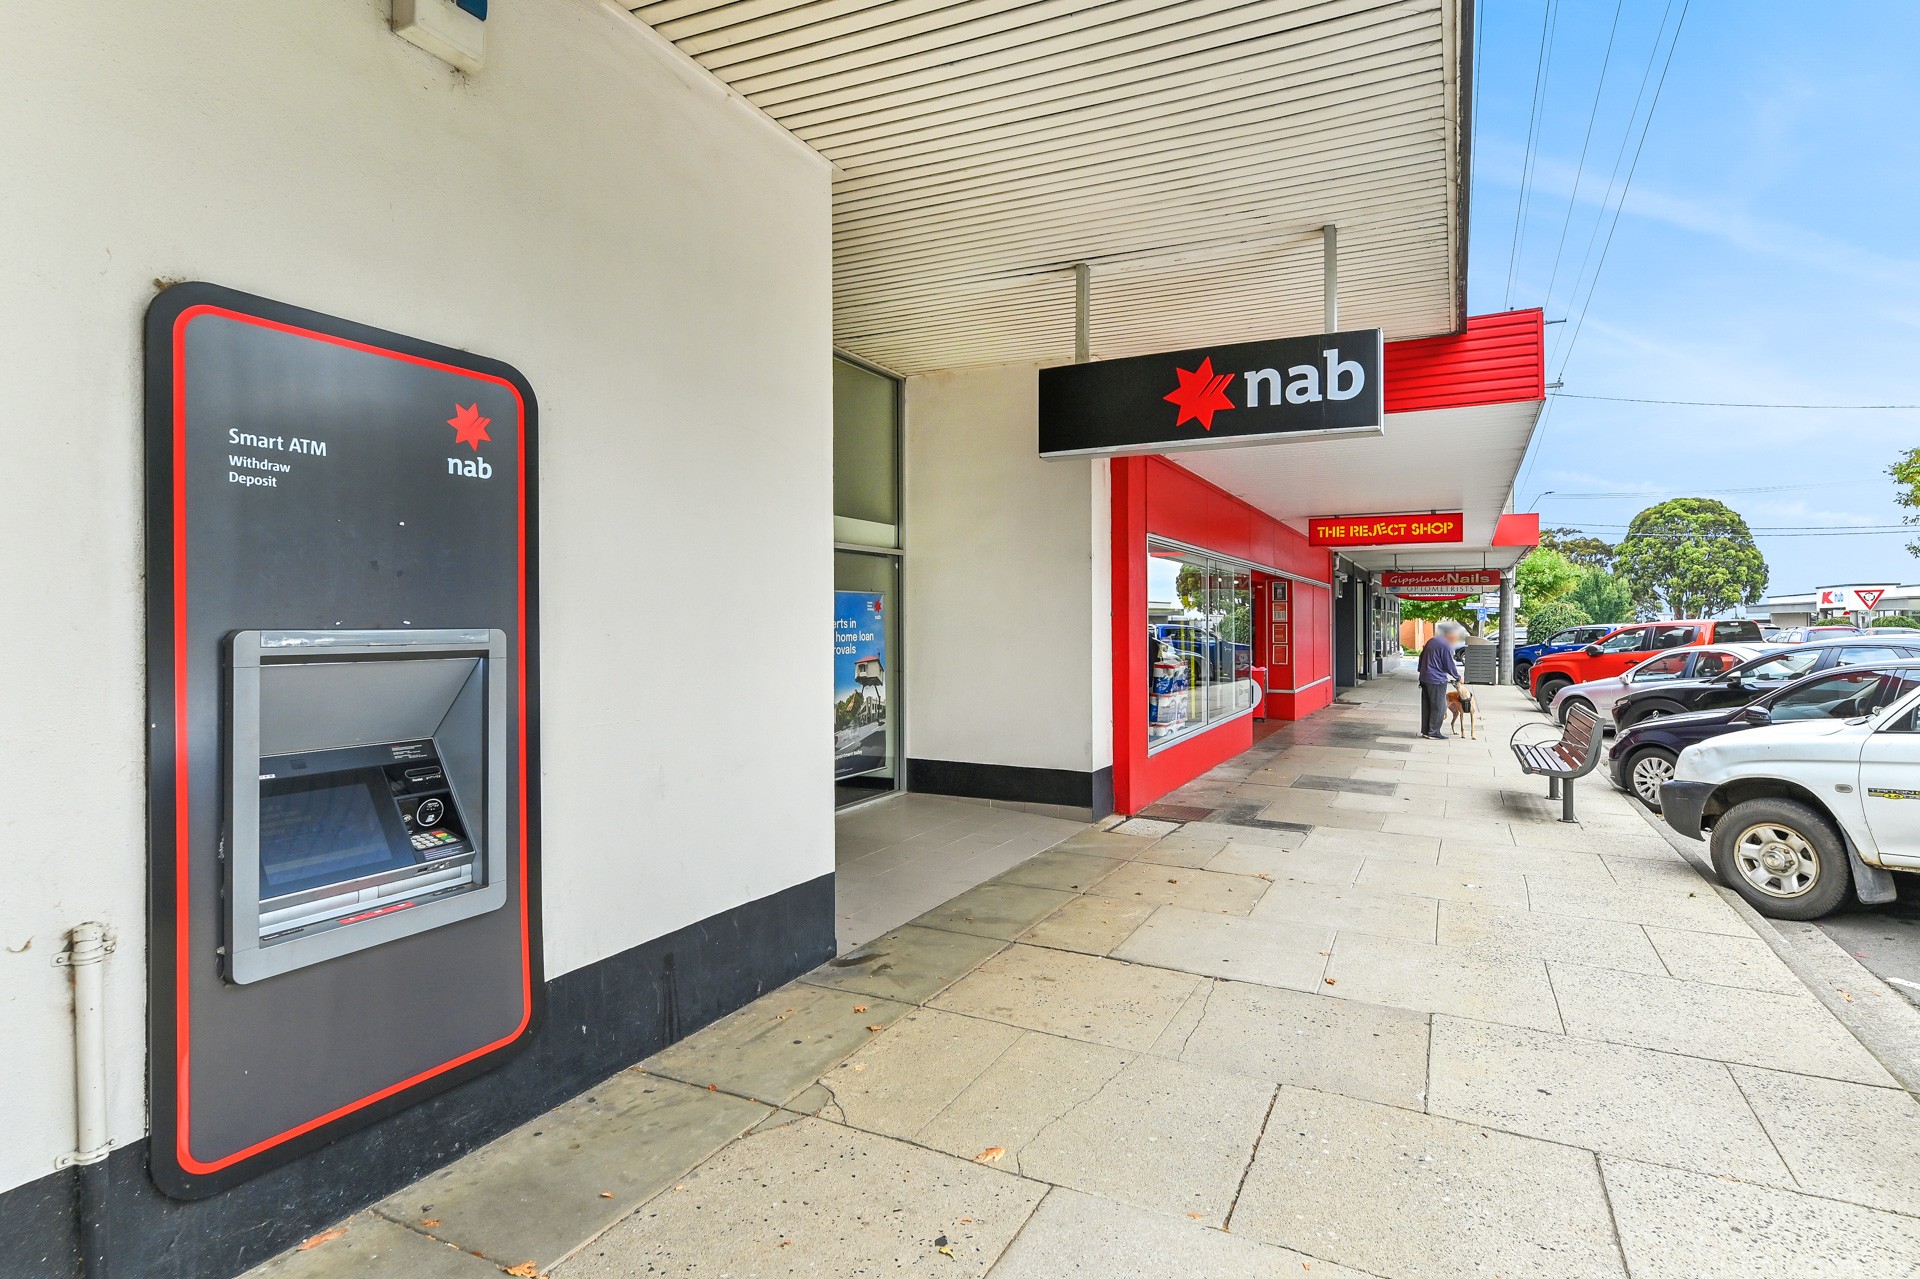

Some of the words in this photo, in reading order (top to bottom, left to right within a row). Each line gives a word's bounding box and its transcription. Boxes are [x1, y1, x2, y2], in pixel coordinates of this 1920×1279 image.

[1244, 348, 1365, 408] nab
[229, 428, 284, 451] Smart
[289, 437, 327, 457] ATM
[229, 455, 291, 473] Withdraw
[447, 456, 493, 479] nab
[229, 471, 278, 487] Deposit
[1317, 526, 1345, 538] THE
[1350, 522, 1407, 537] REJECT
[1411, 522, 1454, 536] SHOP
[849, 618, 857, 629] in
[835, 631, 858, 642] home
[859, 631, 874, 642] loan
